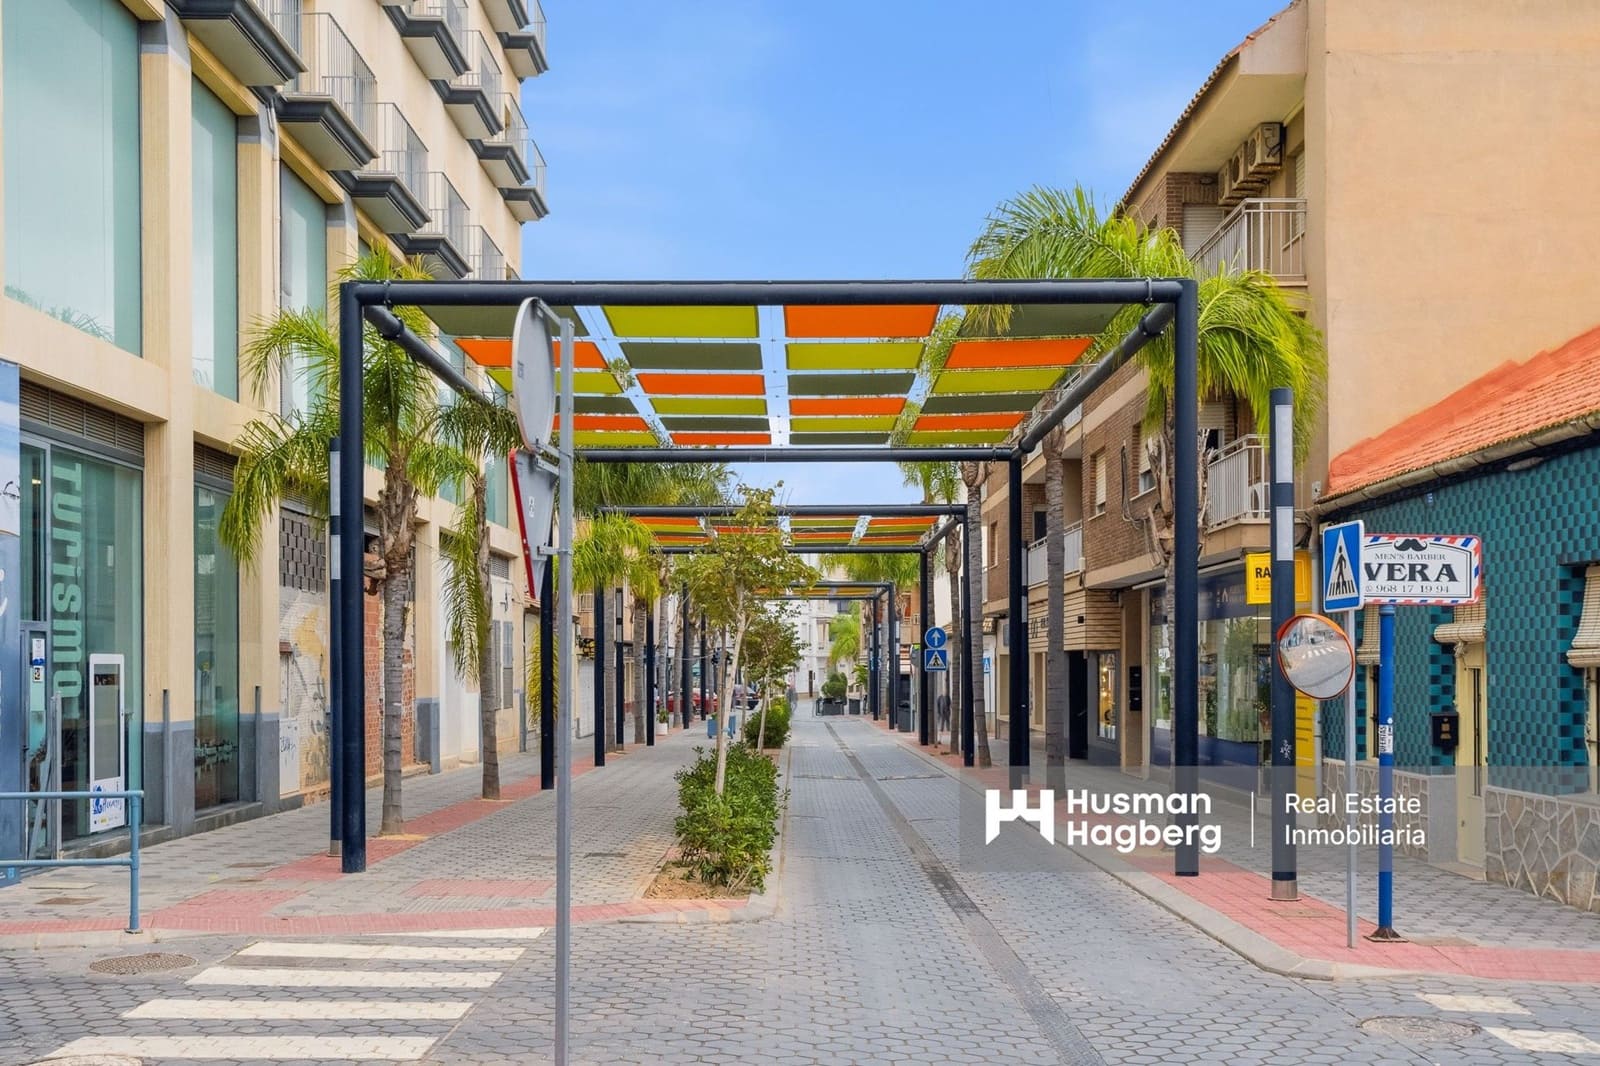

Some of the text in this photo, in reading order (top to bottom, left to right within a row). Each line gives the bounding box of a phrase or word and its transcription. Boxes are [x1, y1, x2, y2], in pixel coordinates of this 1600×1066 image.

[1364, 563, 1459, 582] VERA
[1376, 585, 1450, 593] 968 17 19 94
